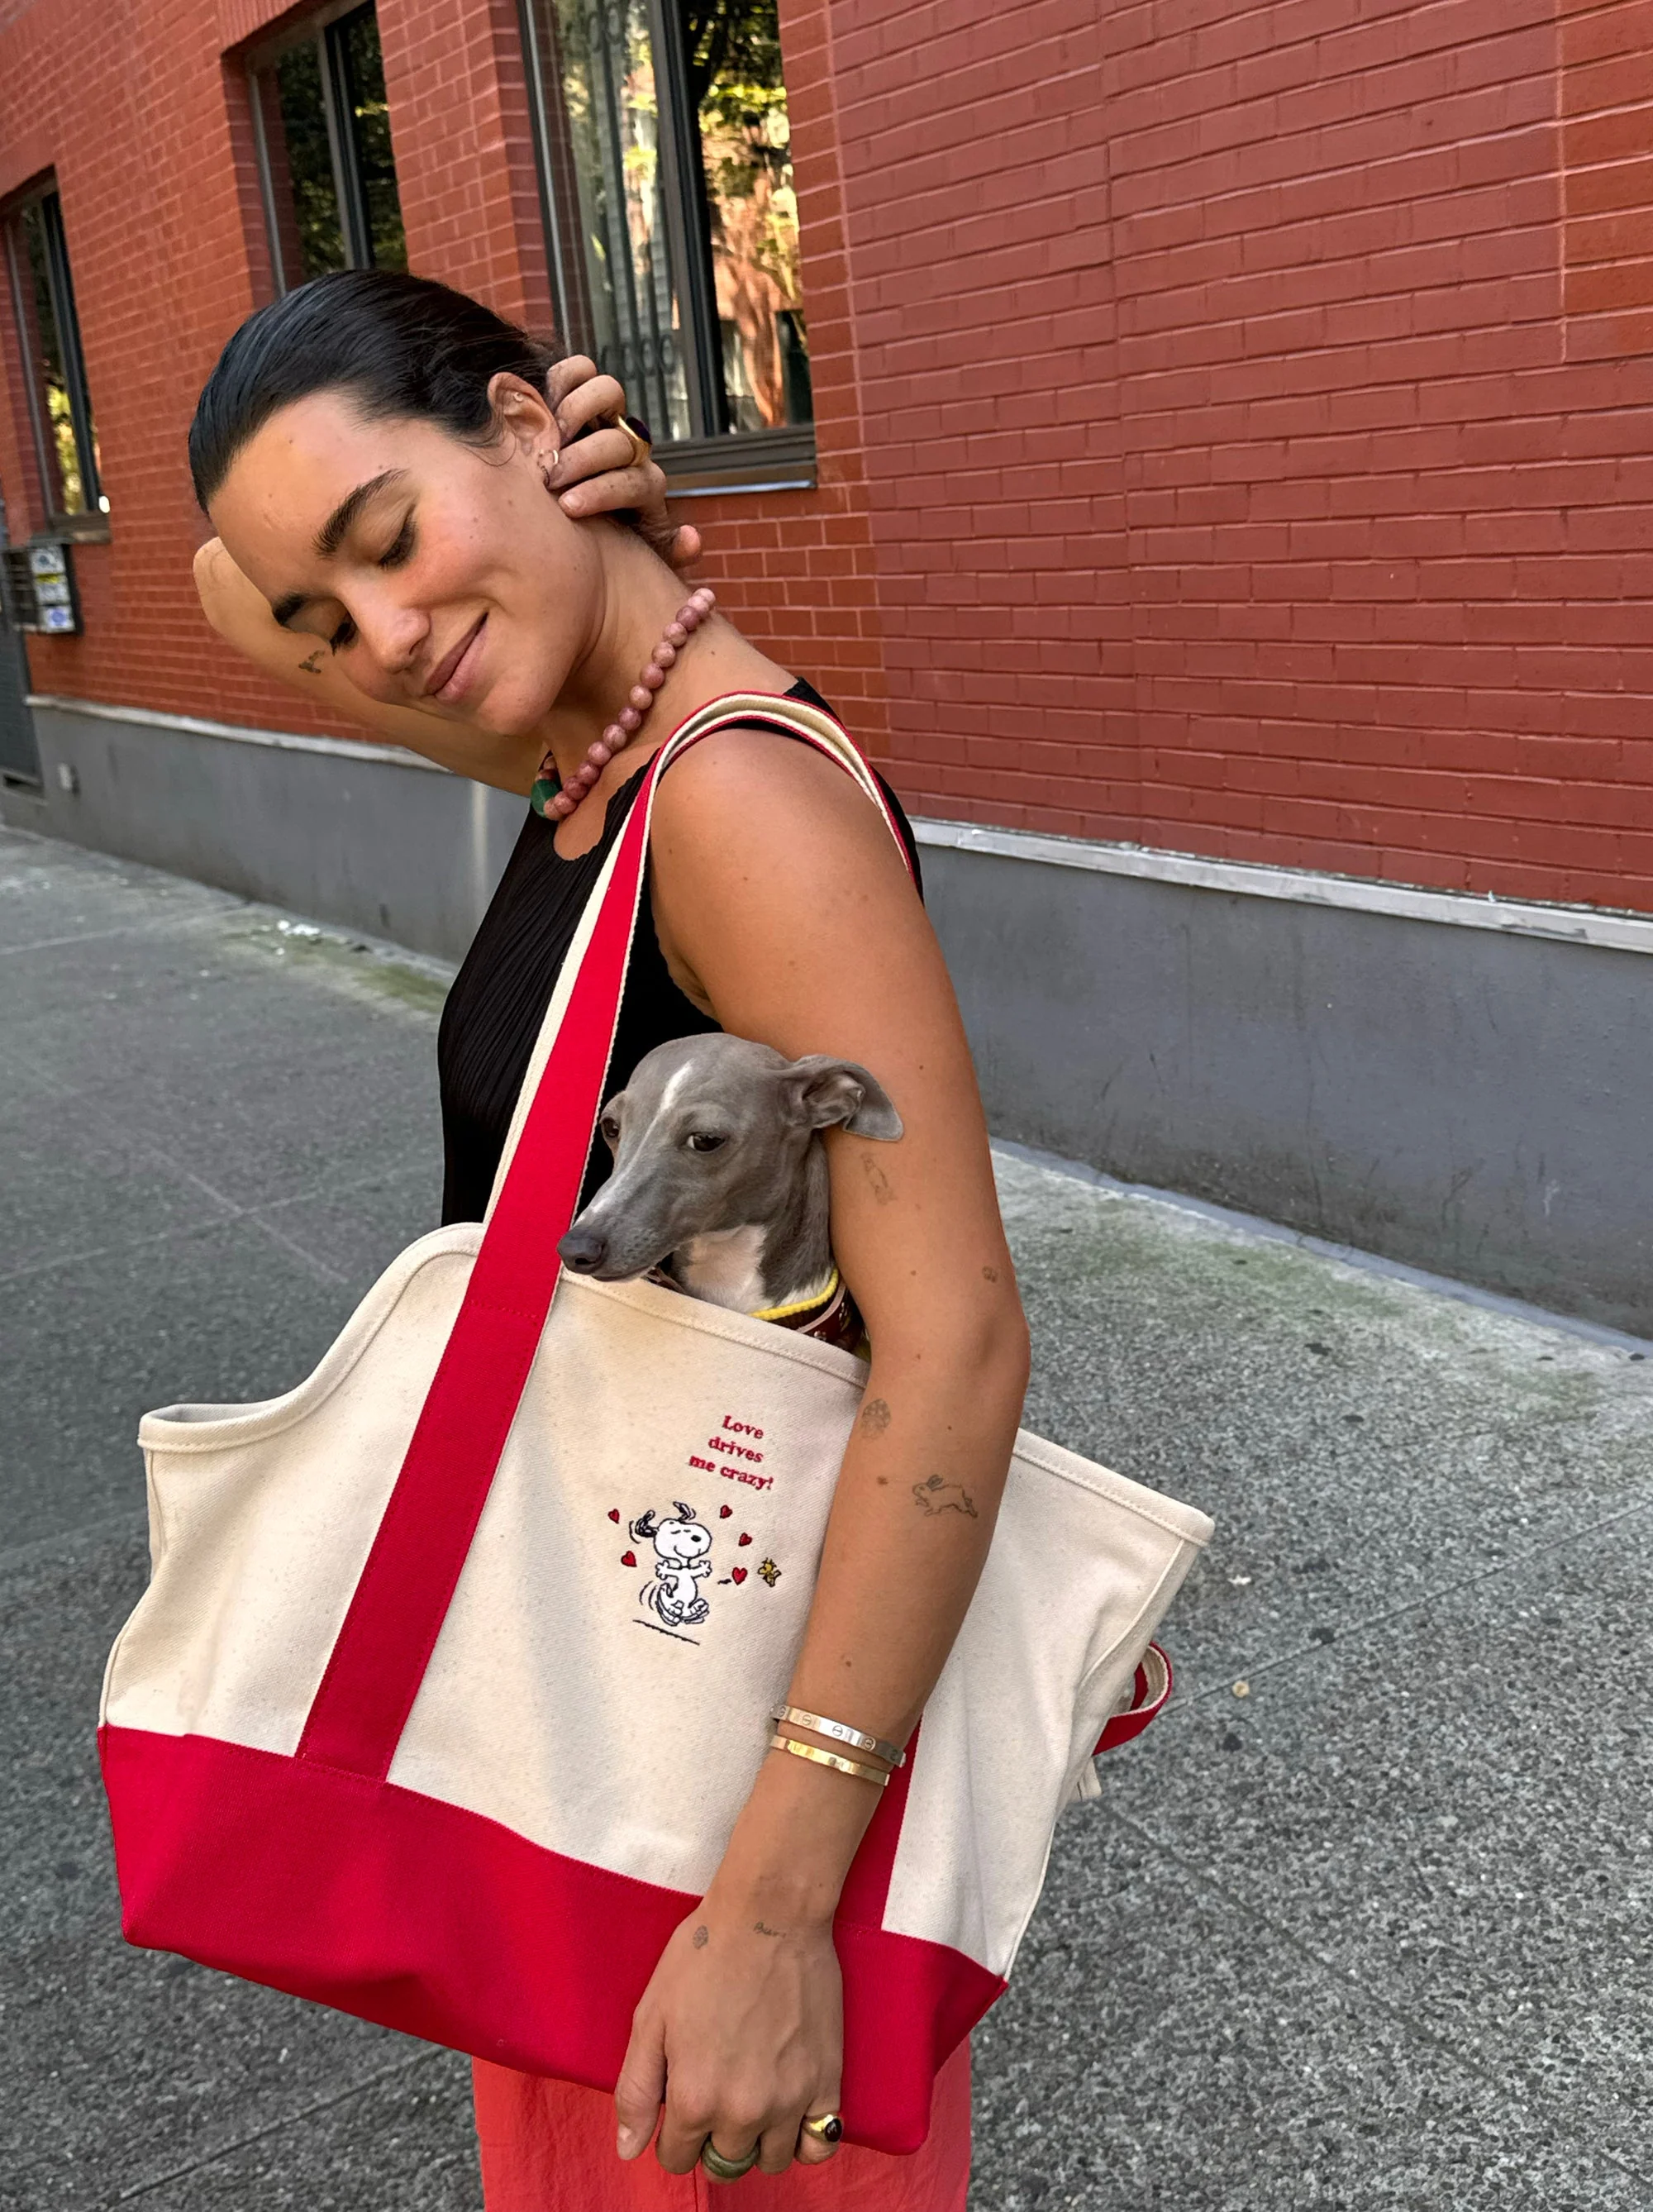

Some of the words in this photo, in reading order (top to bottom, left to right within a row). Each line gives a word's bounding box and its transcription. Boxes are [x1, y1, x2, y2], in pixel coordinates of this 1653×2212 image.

[722, 1415, 764, 1439] Love
[708, 1437, 764, 1462] drives
[688, 1455, 716, 1472] me
[720, 1466, 774, 1490] crazy!
